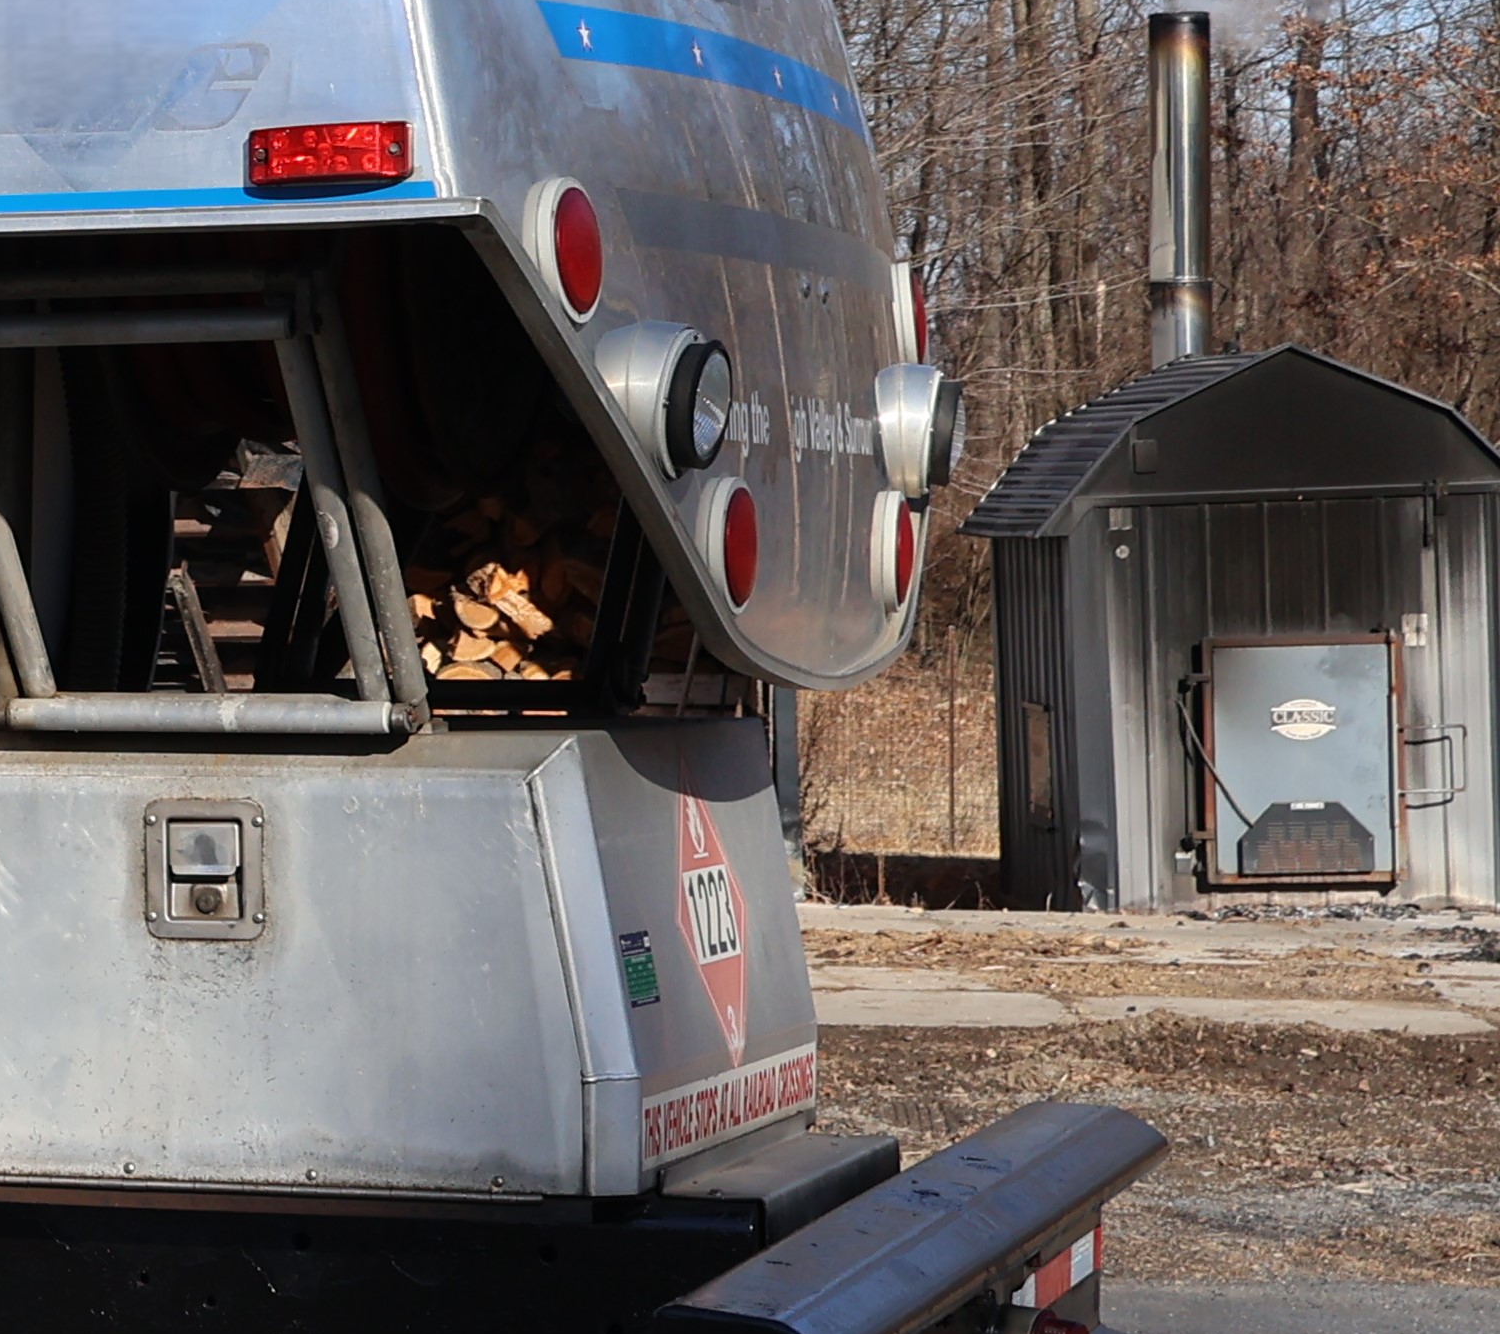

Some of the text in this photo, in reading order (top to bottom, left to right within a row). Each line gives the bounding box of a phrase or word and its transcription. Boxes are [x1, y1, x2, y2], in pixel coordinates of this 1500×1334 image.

[751, 390, 770, 445] the
[807, 397, 835, 465] Valley
[836, 401, 844, 453] &
[1272, 710, 1335, 724] CLASSIC
[688, 869, 737, 959] 1223
[727, 1004, 739, 1048] 3
[645, 1052, 814, 1159] THIS VEHICLE STOPS AT ALL RAILROAD CROSSINGS
